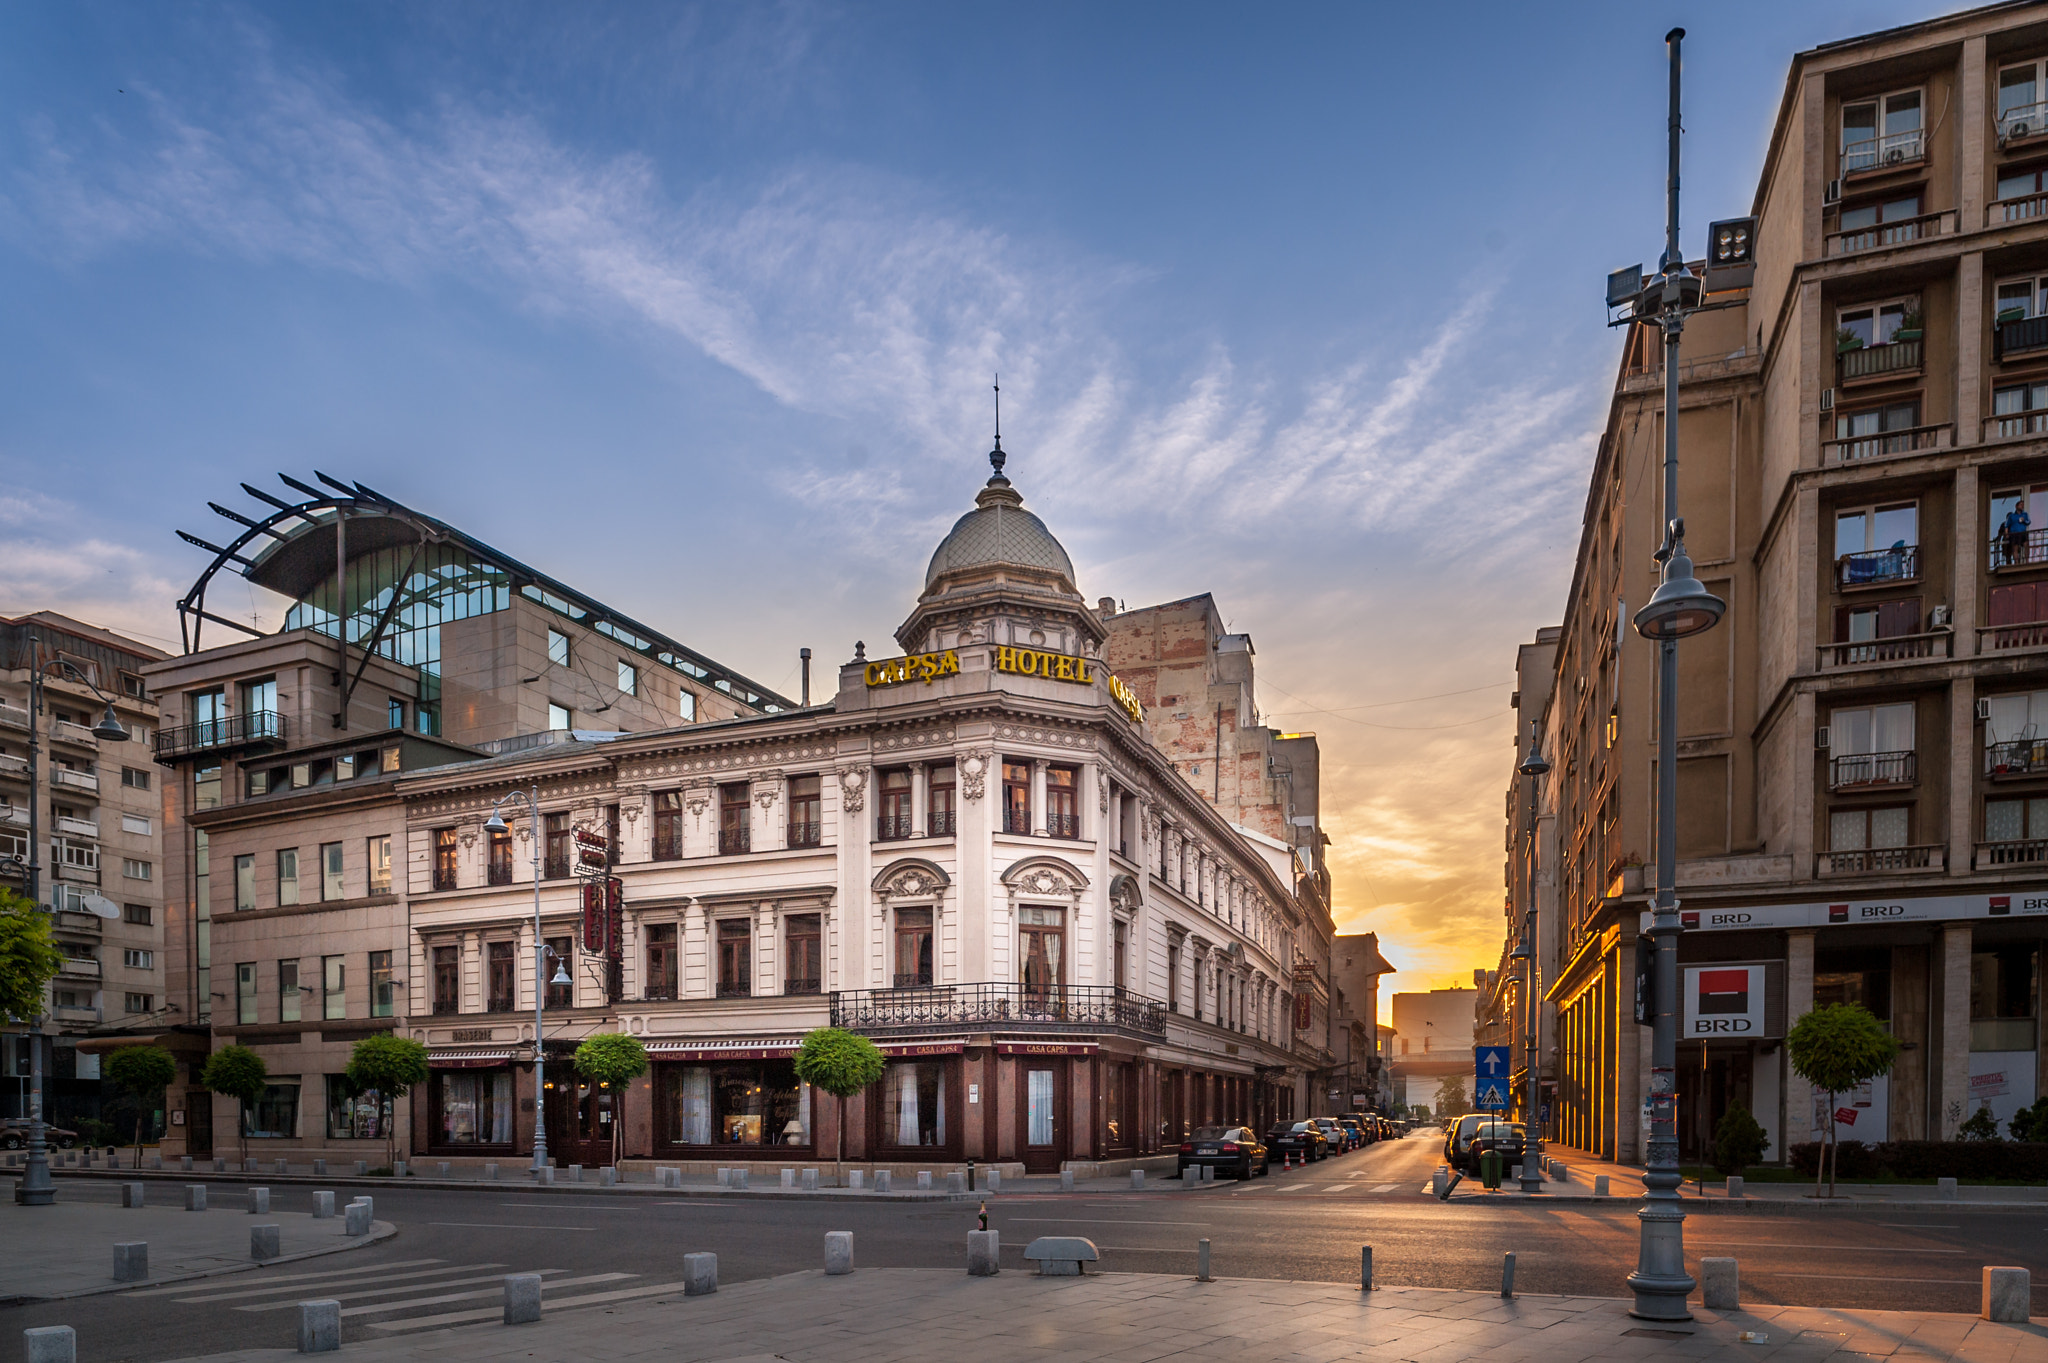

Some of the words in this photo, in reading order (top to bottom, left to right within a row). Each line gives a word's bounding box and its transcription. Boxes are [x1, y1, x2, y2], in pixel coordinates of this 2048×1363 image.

[864, 650, 960, 686] CAPŞA
[997, 646, 1094, 685] HOTEL
[1862, 906, 1904, 917] BRD
[591, 885, 603, 951] HOTEL
[1712, 913, 1752, 924] BRD
[1695, 1019, 1752, 1032] BRD
[917, 1046, 935, 1054] CASA
[1026, 1045, 1045, 1053] CASA
[1046, 1045, 1069, 1054] CAPSA
[1541, 1106, 1548, 1116] P
